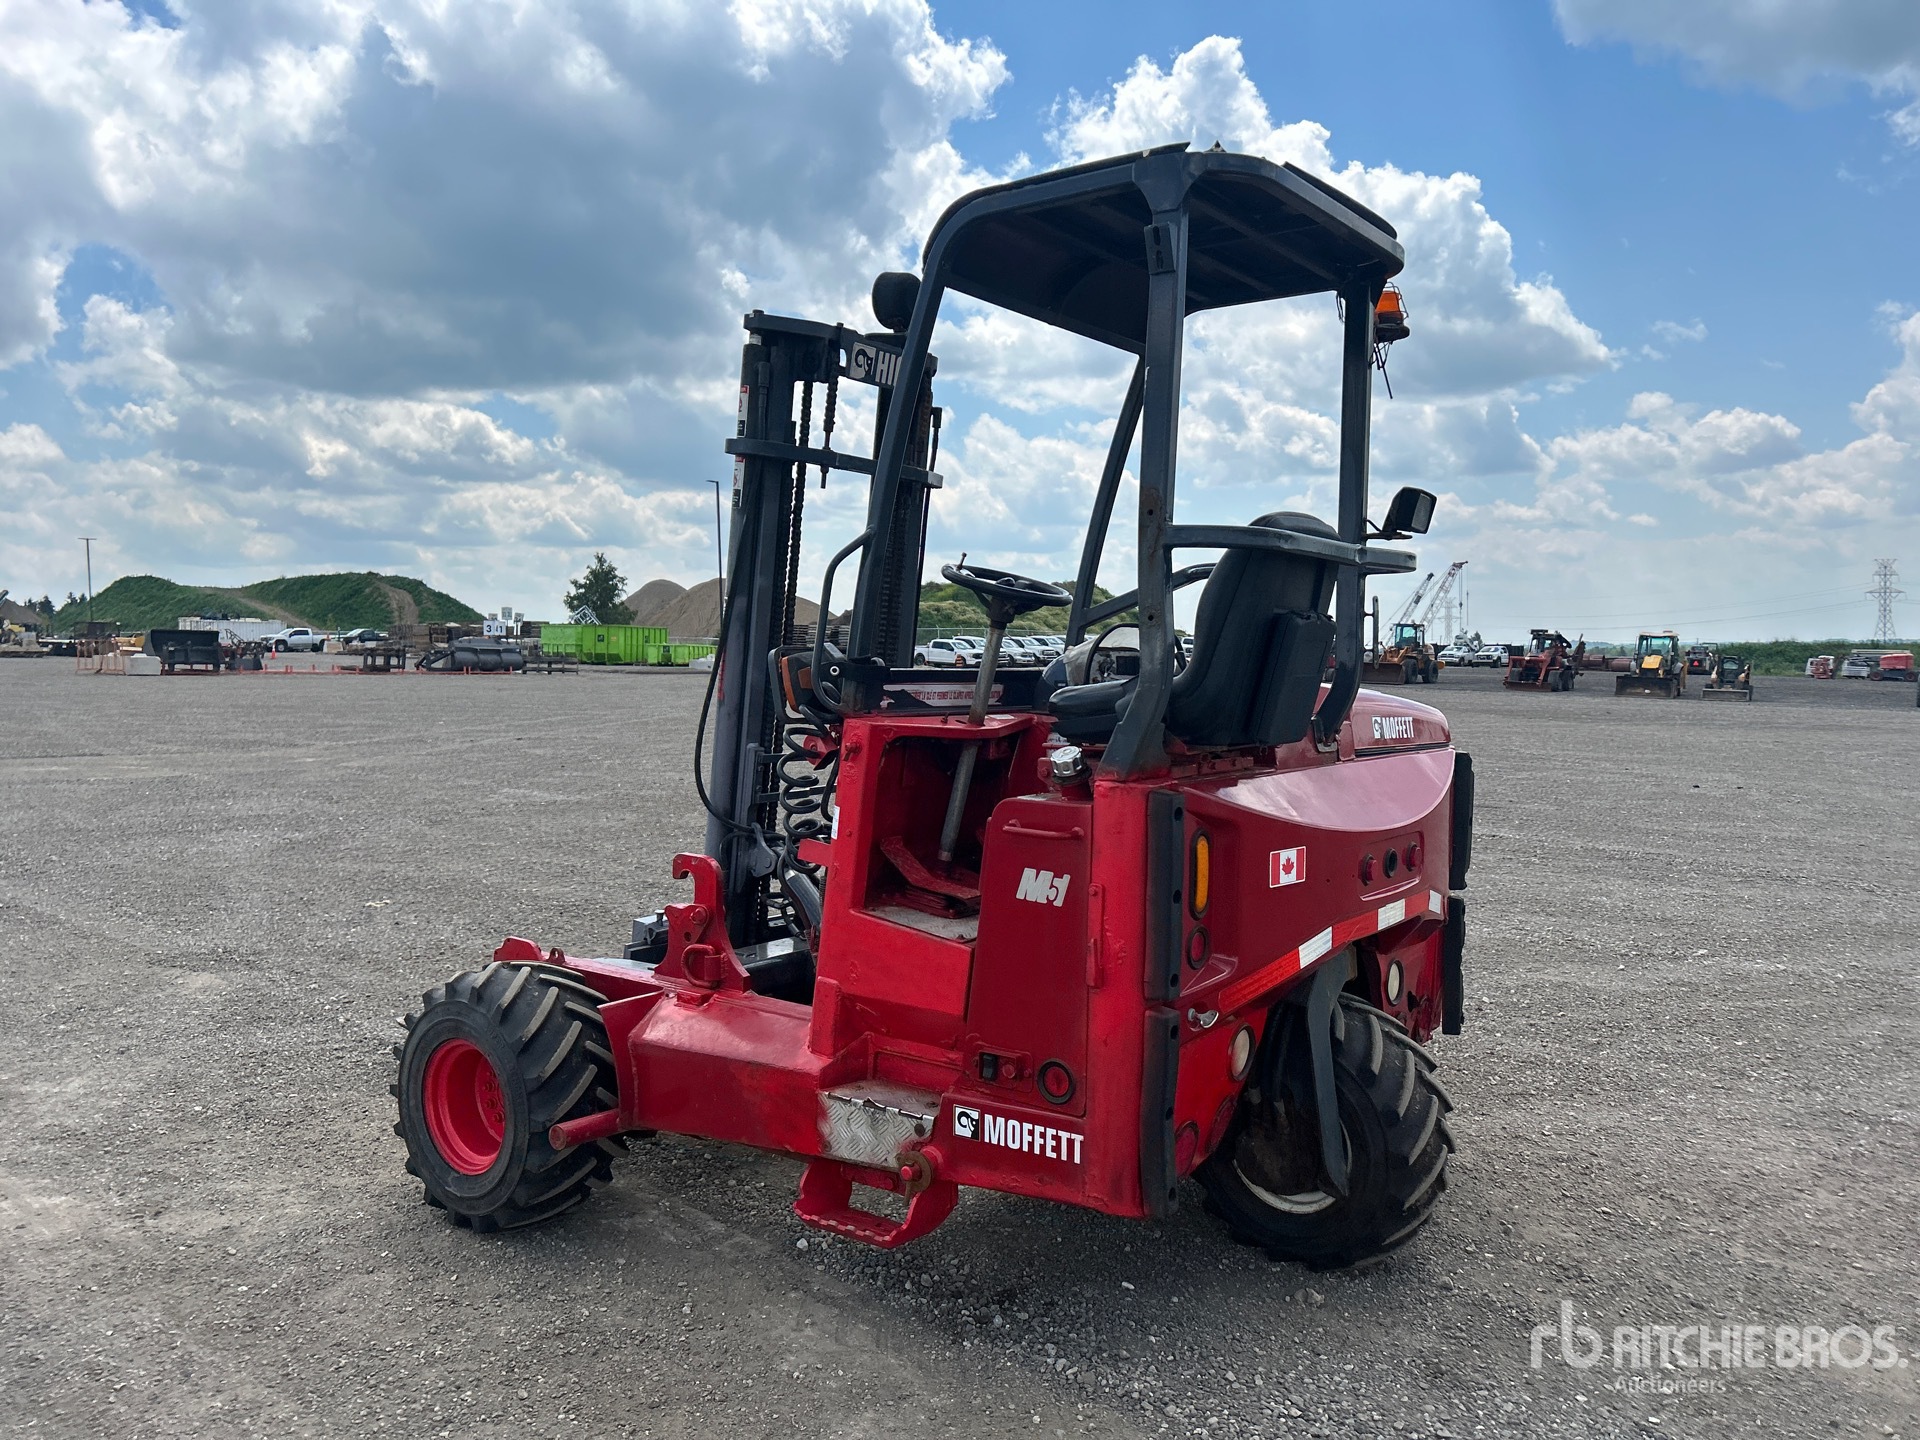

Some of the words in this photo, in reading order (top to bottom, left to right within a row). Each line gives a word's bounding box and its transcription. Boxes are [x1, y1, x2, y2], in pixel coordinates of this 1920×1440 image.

[1382, 716, 1414, 739] MOFFETT
[1016, 867, 1071, 907] M5
[984, 1114, 1084, 1164] MOFFETT
